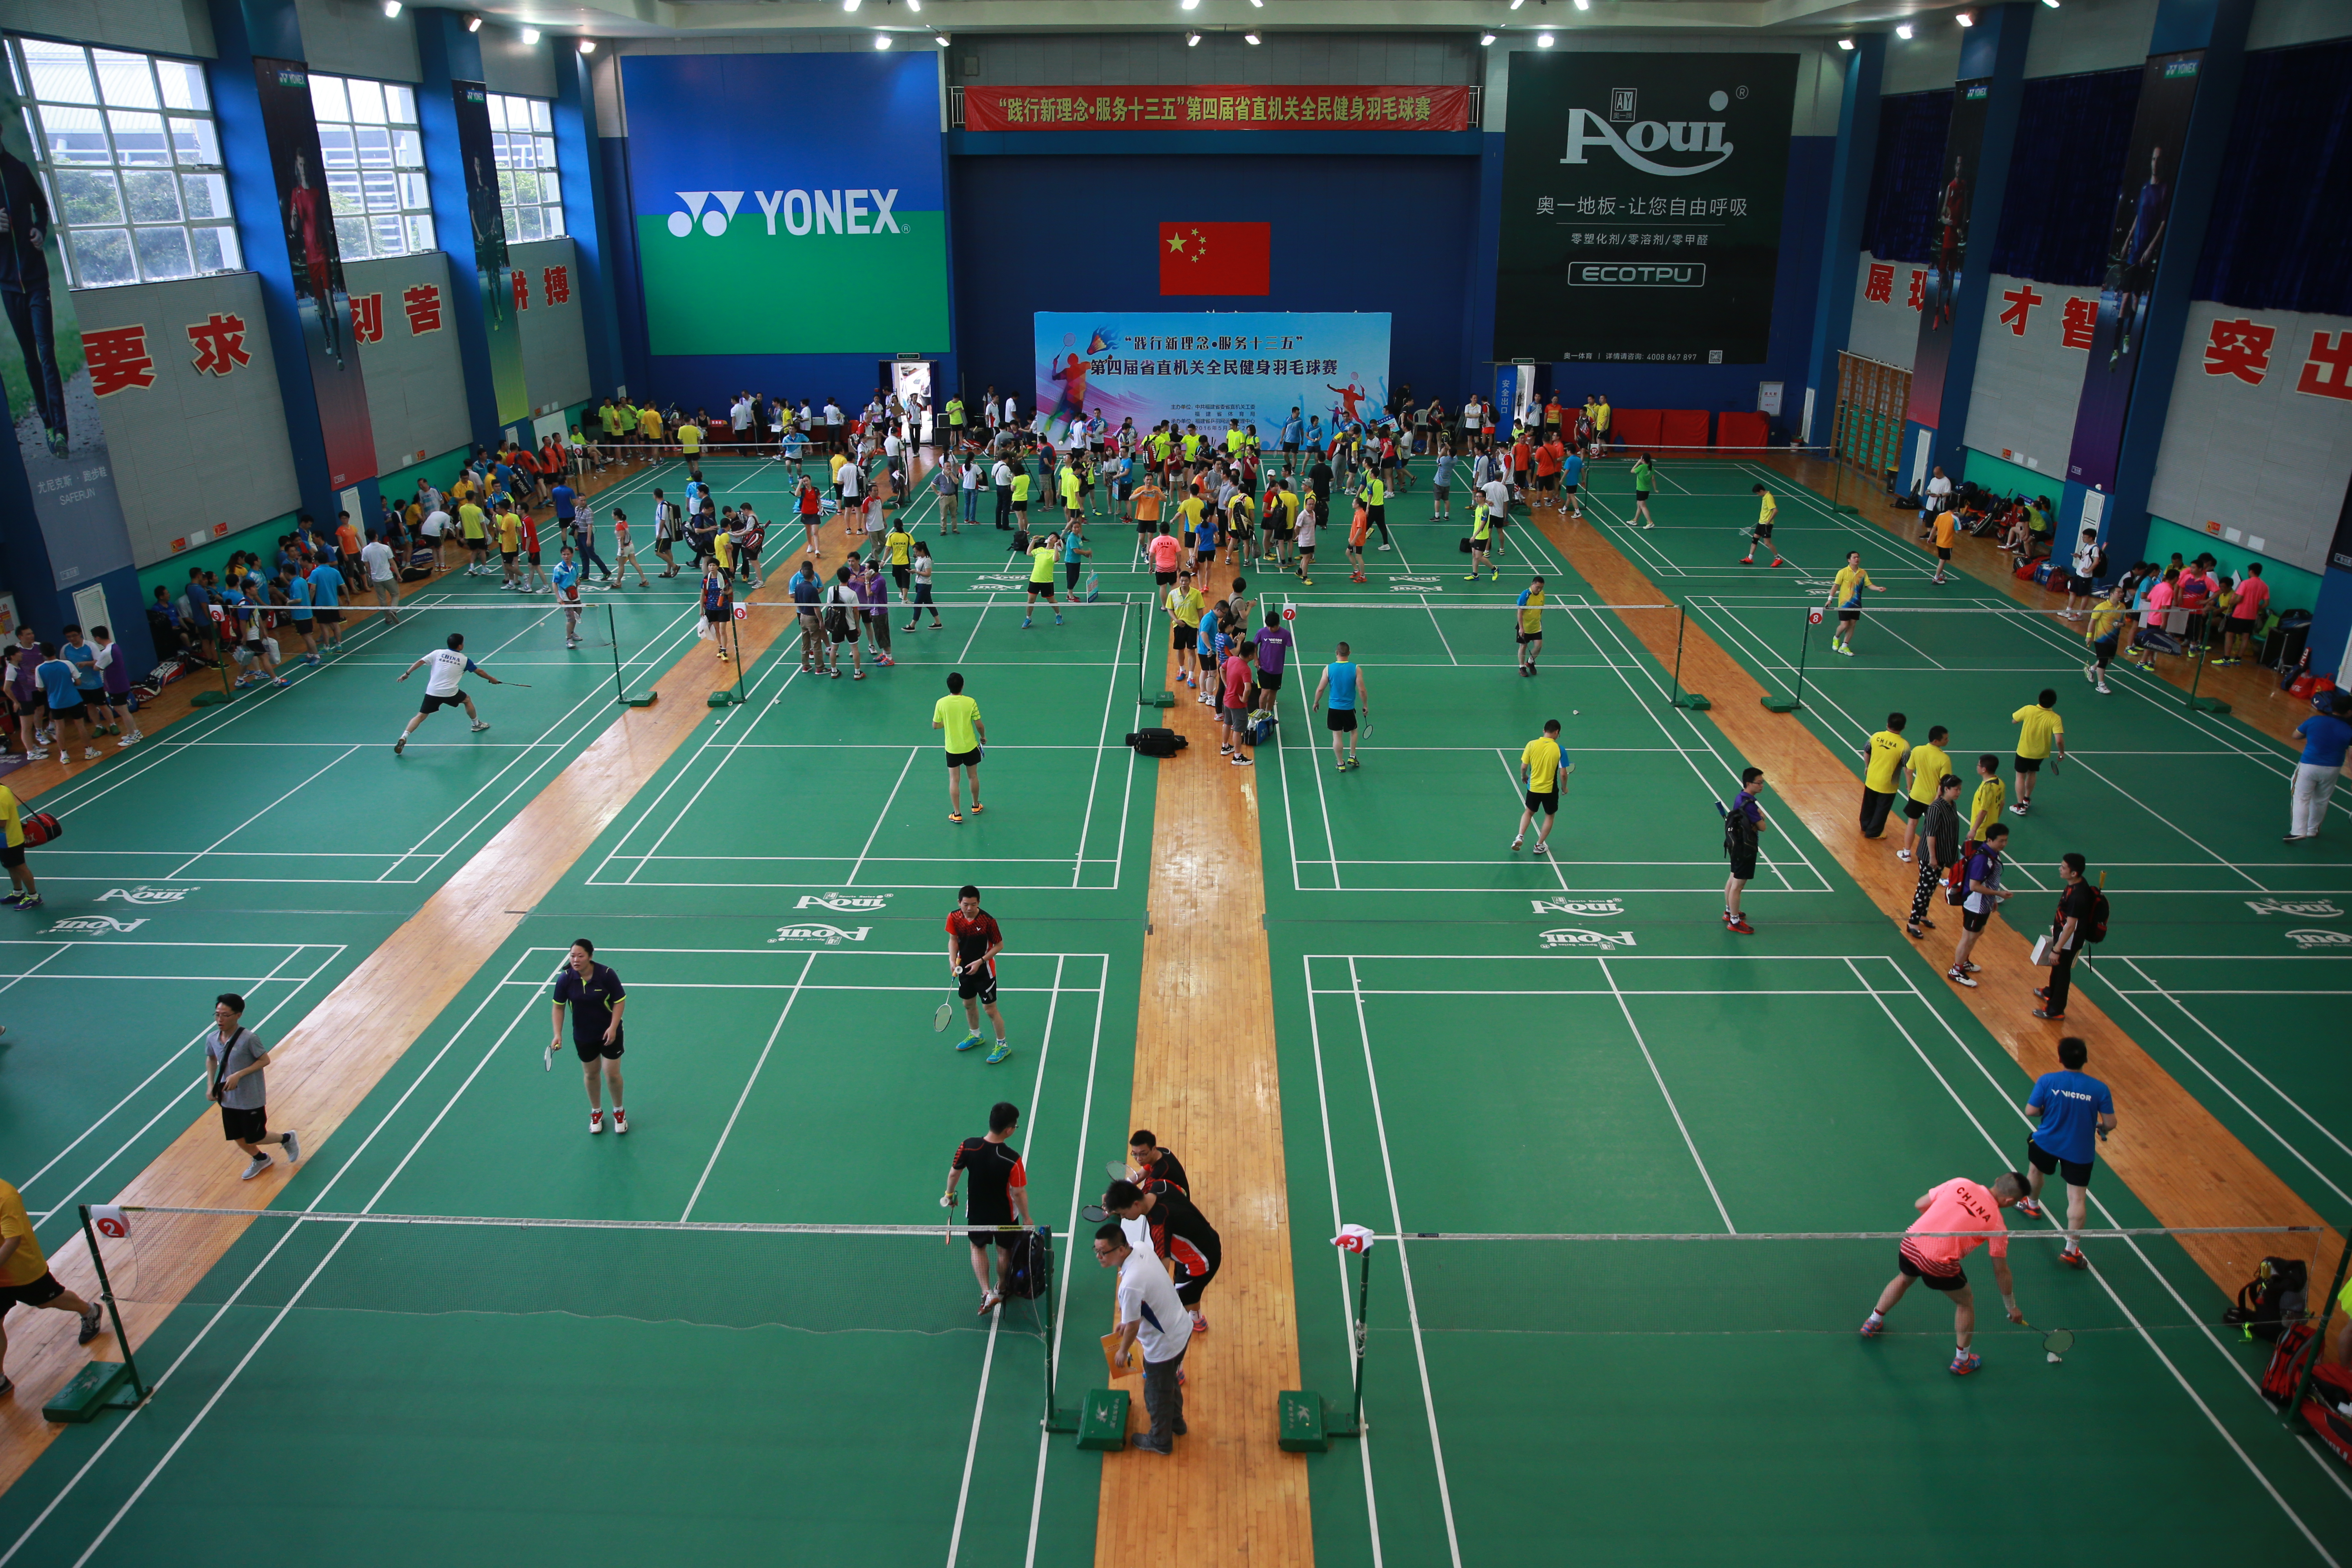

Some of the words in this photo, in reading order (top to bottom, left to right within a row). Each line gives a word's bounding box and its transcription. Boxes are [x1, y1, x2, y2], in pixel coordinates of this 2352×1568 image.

[289, 74, 305, 85] YONEX
[754, 189, 901, 236] YONEX
[1536, 196, 1747, 216] 奥一地板-让您自由呼吸
[1583, 267, 1691, 282] ECOTPU
[1091, 359, 1338, 376] 第四届省直机关全民健身羽毛球赛
[1502, 382, 1510, 414] 安全出口
[516, 480, 529, 495] YONEX
[1813, 614, 1819, 622] 8
[441, 653, 461, 662] CHINA
[1876, 737, 1897, 748] CHINA
[2061, 1090, 2092, 1102] VICTOR
[1956, 1186, 1991, 1223] CHINA
[103, 1221, 119, 1236] 2
